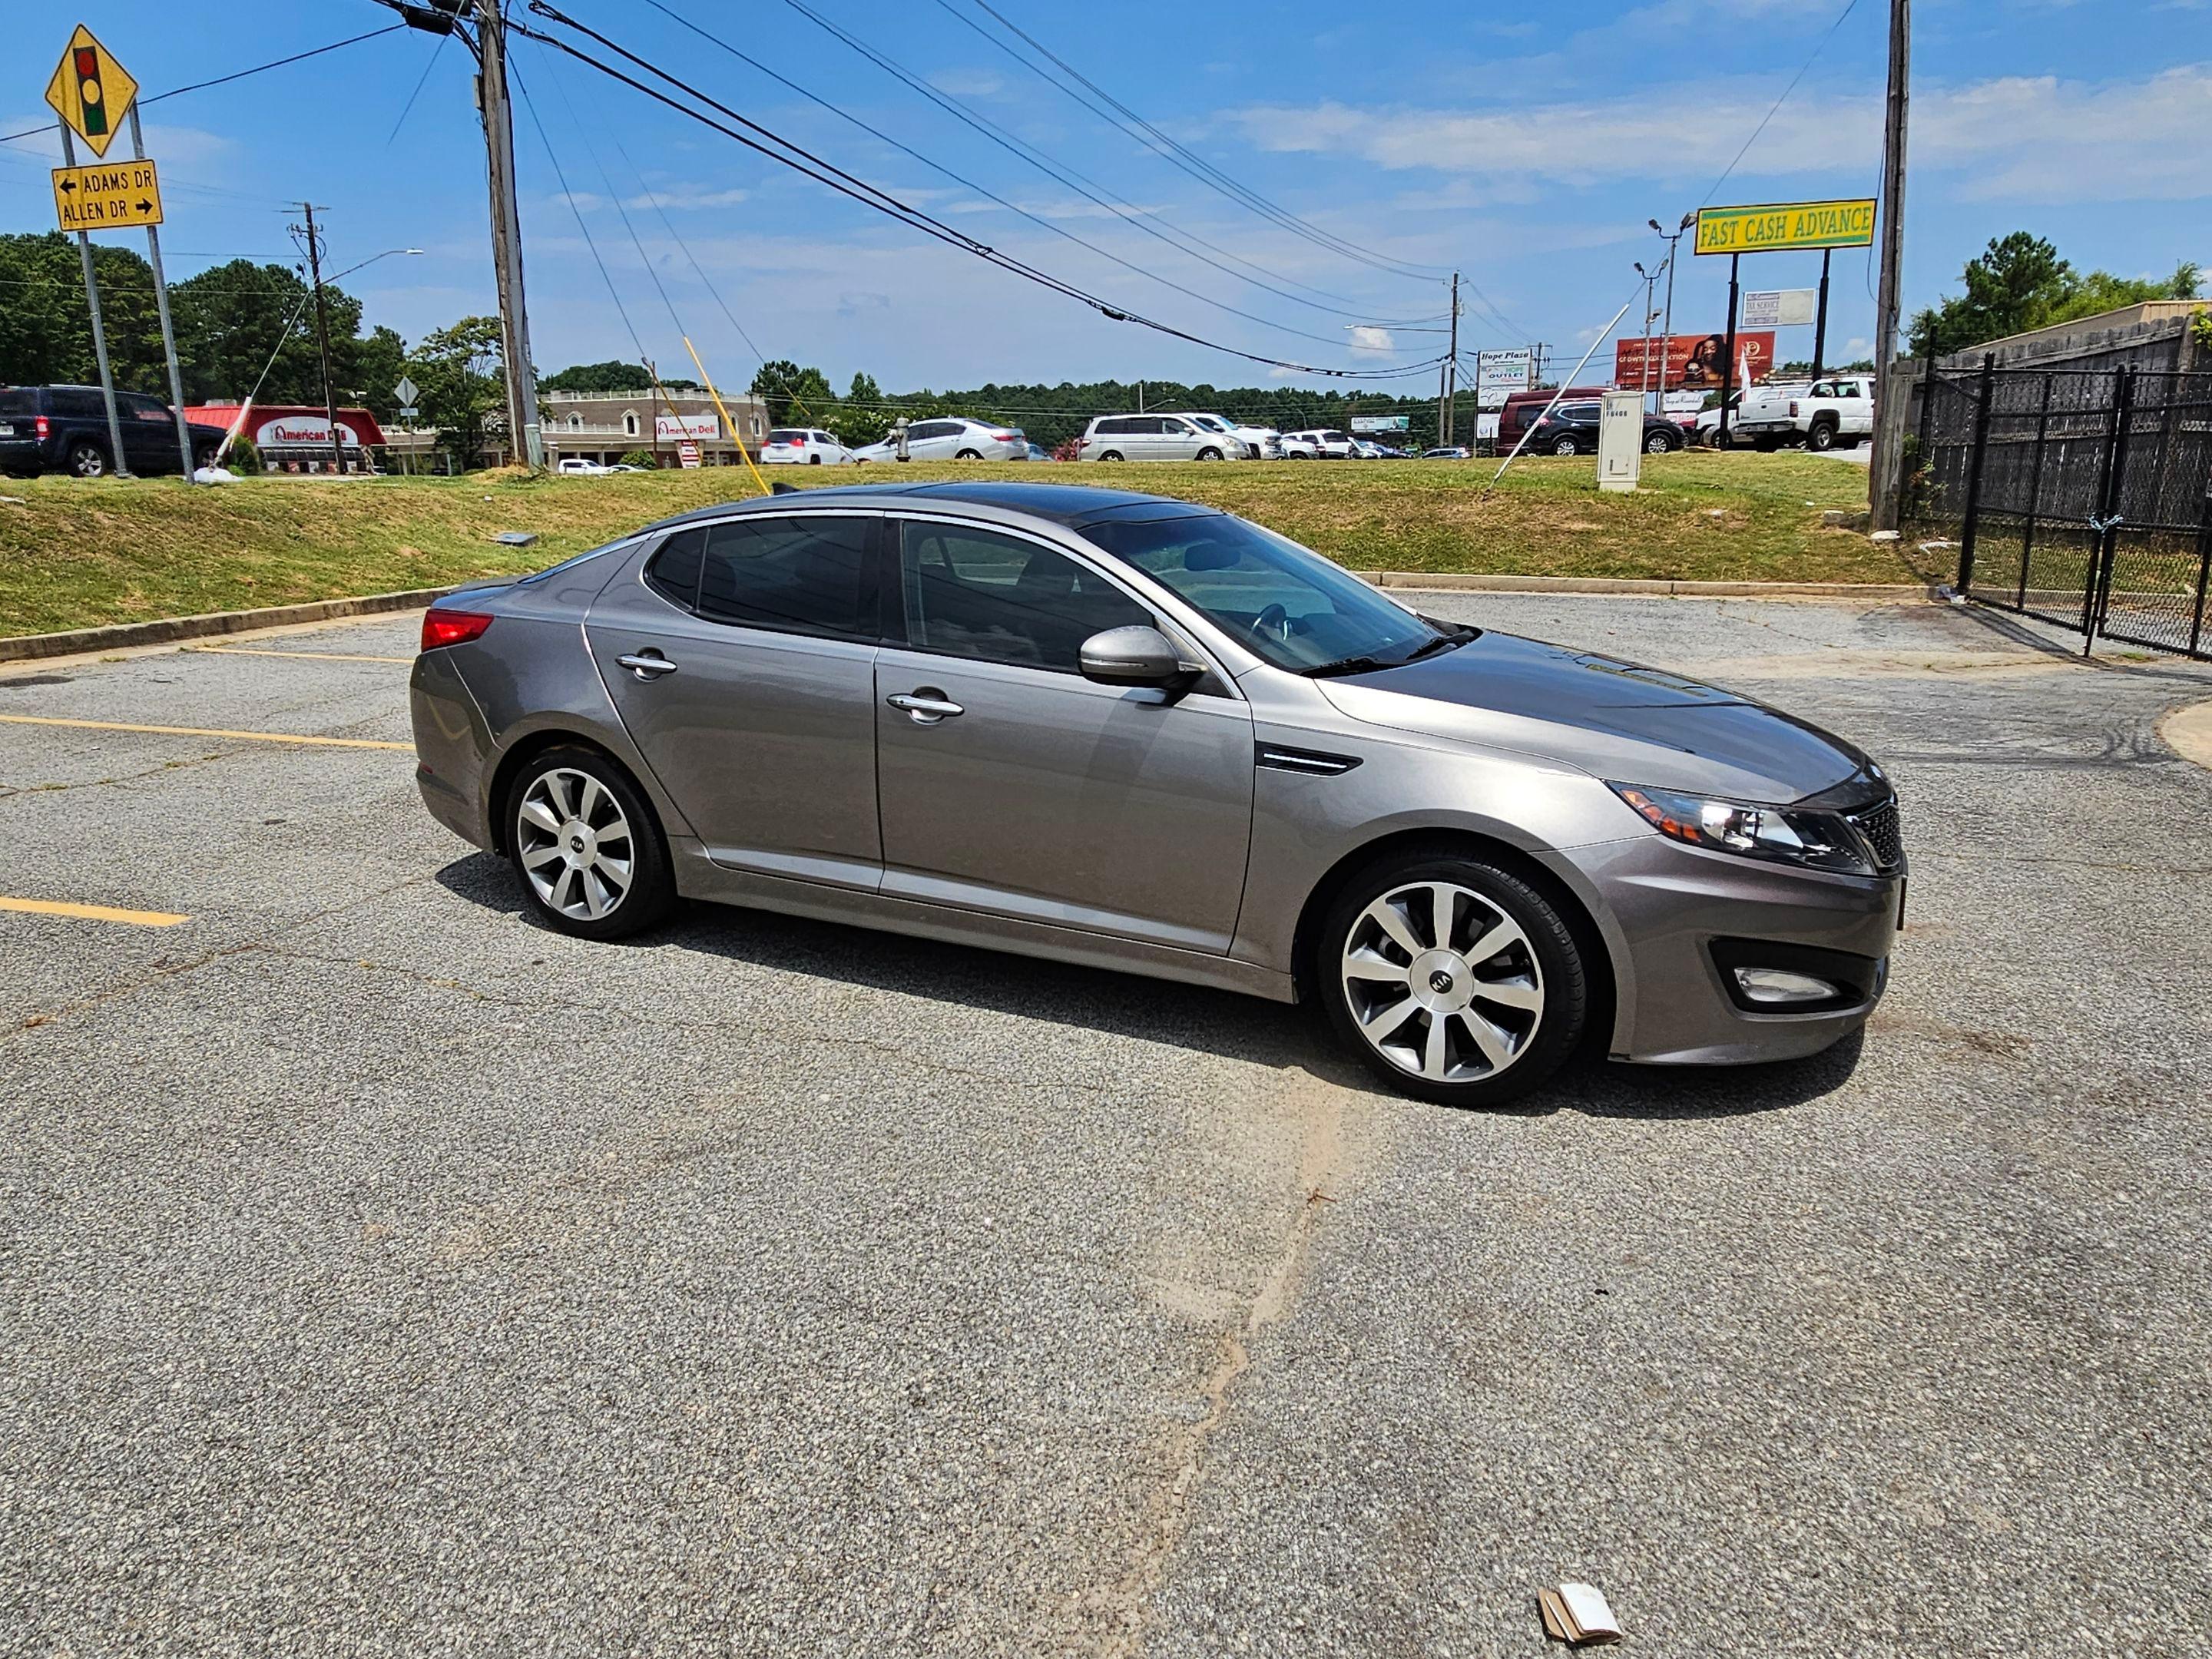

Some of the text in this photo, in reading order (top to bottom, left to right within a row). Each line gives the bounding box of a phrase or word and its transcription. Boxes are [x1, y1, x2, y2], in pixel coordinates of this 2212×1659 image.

[84, 170, 153, 193] ADAMS DR
[64, 200, 127, 222] ALLEN DR
[1700, 207, 1872, 247] FAST CASH ADVANCE
[274, 425, 346, 441] American Dli
[698, 425, 715, 434] Deli
[571, 841, 583, 849] KIA
[1432, 975, 1451, 991] KIA
